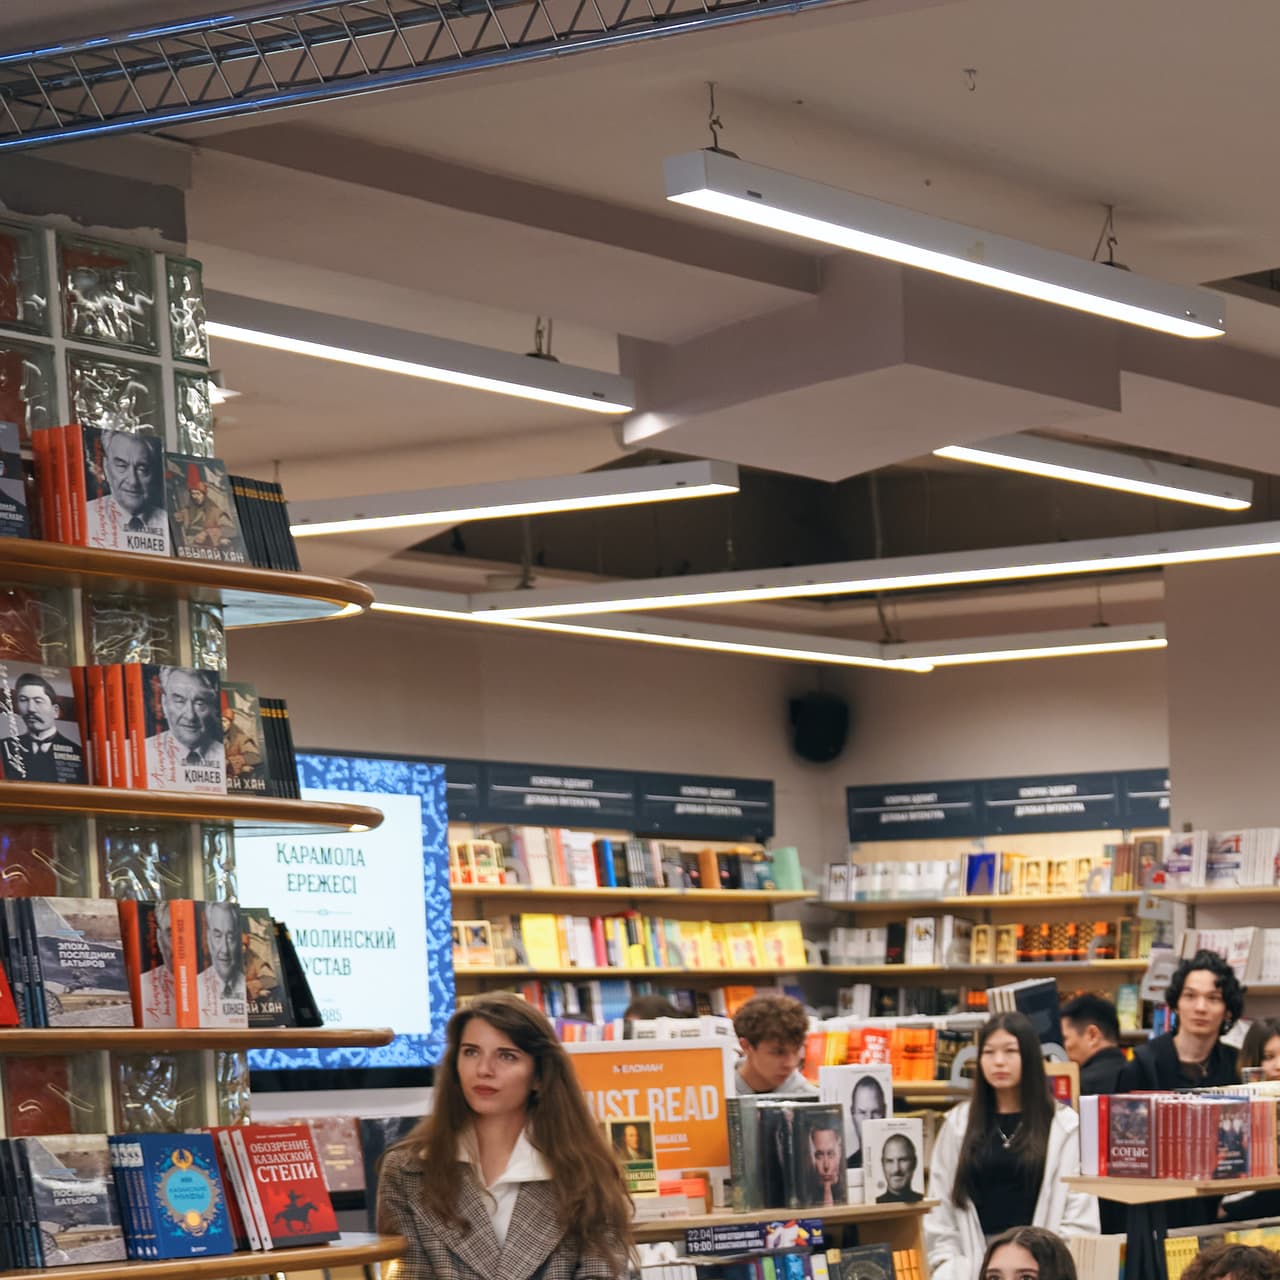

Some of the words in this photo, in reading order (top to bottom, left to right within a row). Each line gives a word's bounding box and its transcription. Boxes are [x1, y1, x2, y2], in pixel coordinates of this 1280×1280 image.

[287, 873, 357, 895] ЕРЕЖЕСІ
[293, 927, 397, 950] МОЛИНСКИЙ
[58, 942, 90, 951] ЭПОХА
[59, 951, 117, 961] ПОСЛЕДНИХ
[60, 959, 105, 969] БАТЫРОВ
[585, 1088, 640, 1119] UST
[646, 1084, 719, 1122] READ
[250, 1140, 310, 1153] ОБОЗРЕНИЕ
[254, 1150, 313, 1165] КАЗАХСКОЙ
[257, 1163, 319, 1183] СТЕПИ
[54, 1196, 98, 1206] БАТЫРОВ
[688, 1229, 711, 1241] 22.04
[688, 1241, 712, 1252] 19:00
